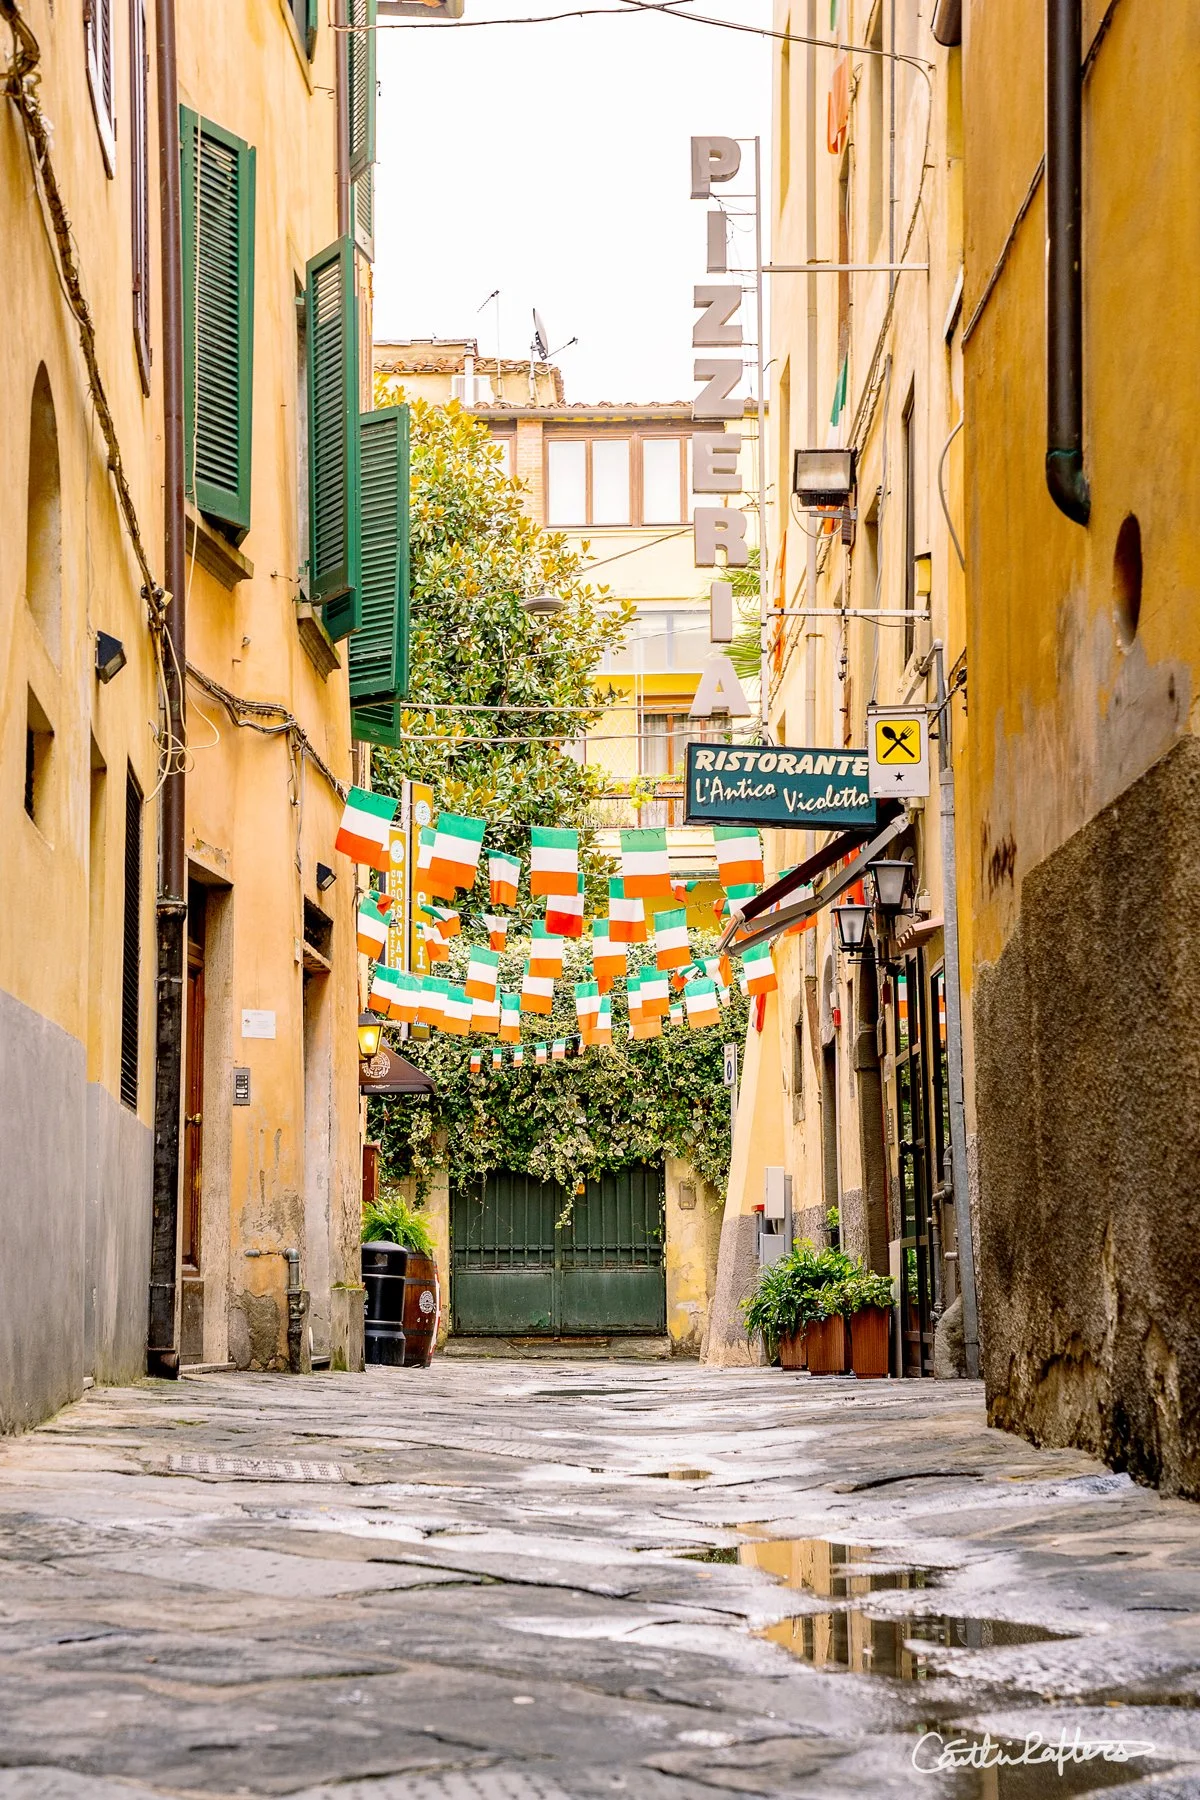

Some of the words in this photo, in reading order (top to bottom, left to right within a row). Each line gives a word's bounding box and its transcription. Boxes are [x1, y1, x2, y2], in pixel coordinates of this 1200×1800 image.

[690, 135, 752, 718] PIZZERIA
[695, 749, 868, 777] RISTORANTE
[696, 775, 777, 804] L'Antico
[783, 784, 870, 812] Vicoletto
